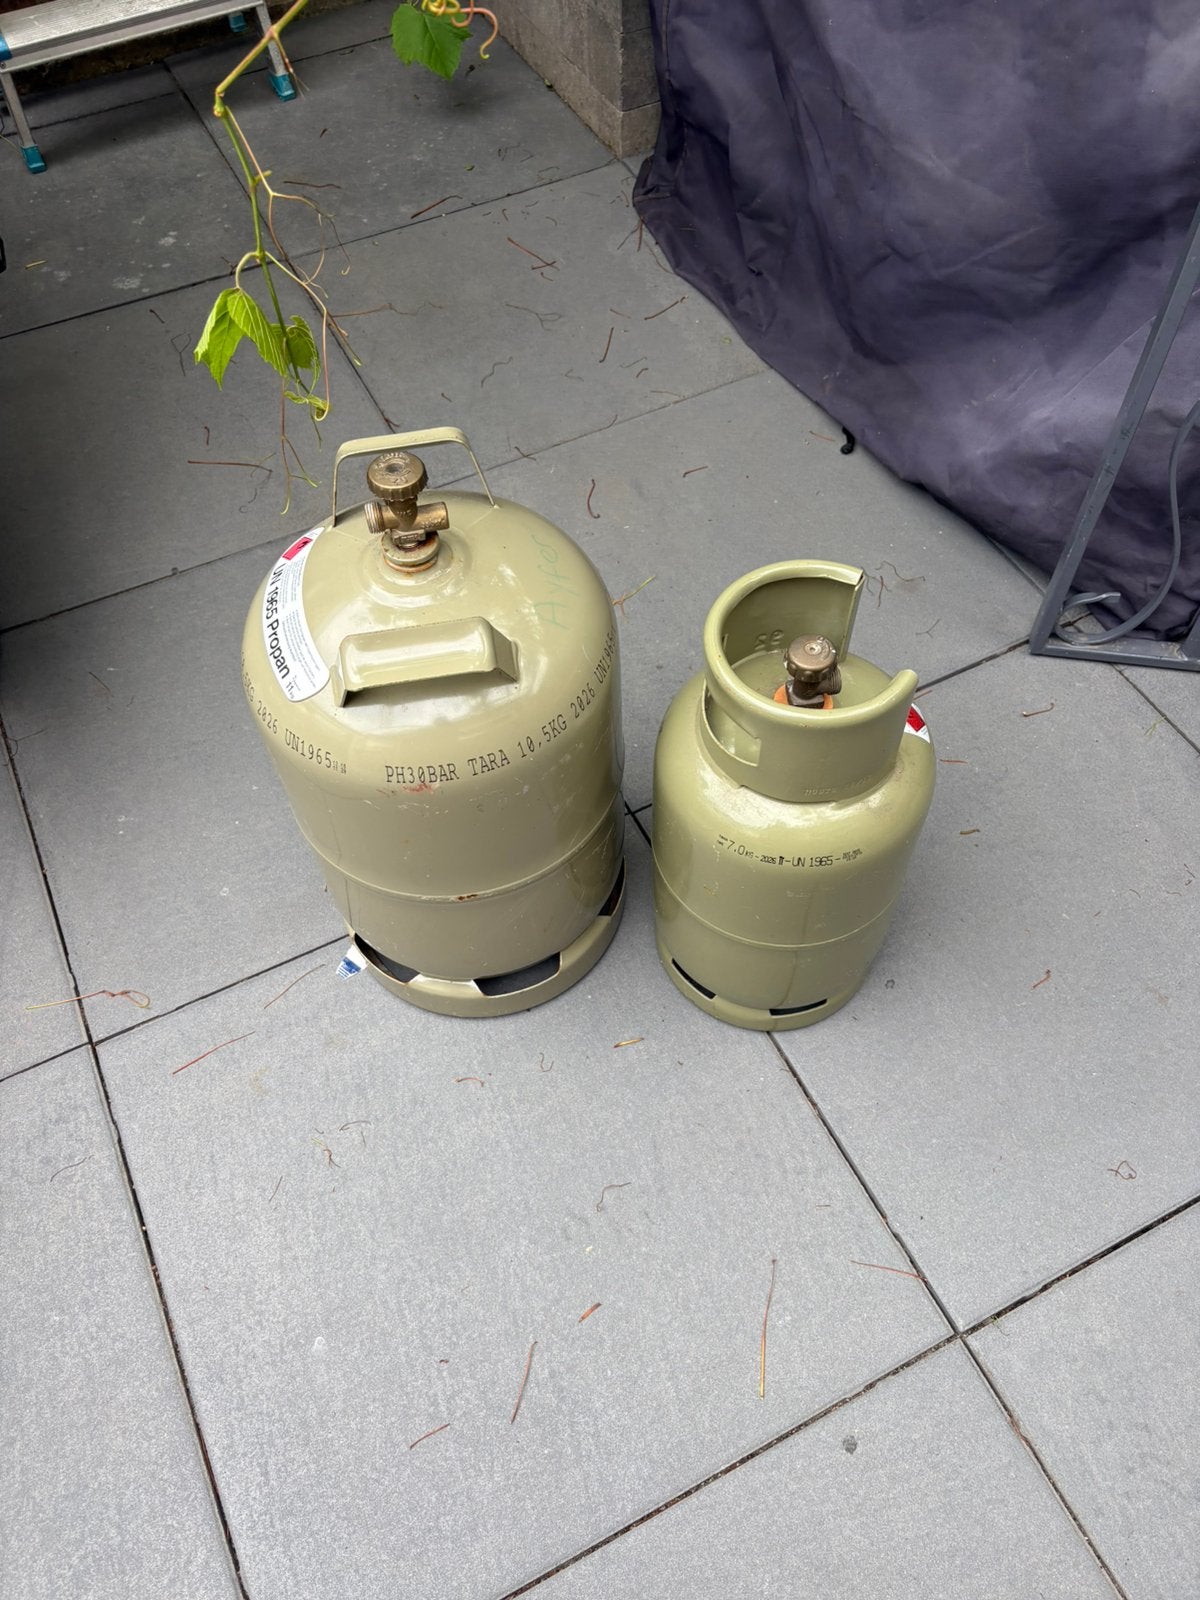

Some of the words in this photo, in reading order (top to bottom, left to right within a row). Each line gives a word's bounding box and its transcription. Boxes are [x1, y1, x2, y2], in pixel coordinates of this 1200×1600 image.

[270, 562, 287, 587] UN
[266, 586, 279, 620] 1965
[267, 618, 290, 680] Propan
[285, 728, 332, 769] UN1965
[385, 763, 460, 784] PH30BAR
[467, 749, 511, 776] TARA
[517, 714, 567, 758] 10,5KG
[570, 682, 595, 719] 2026
